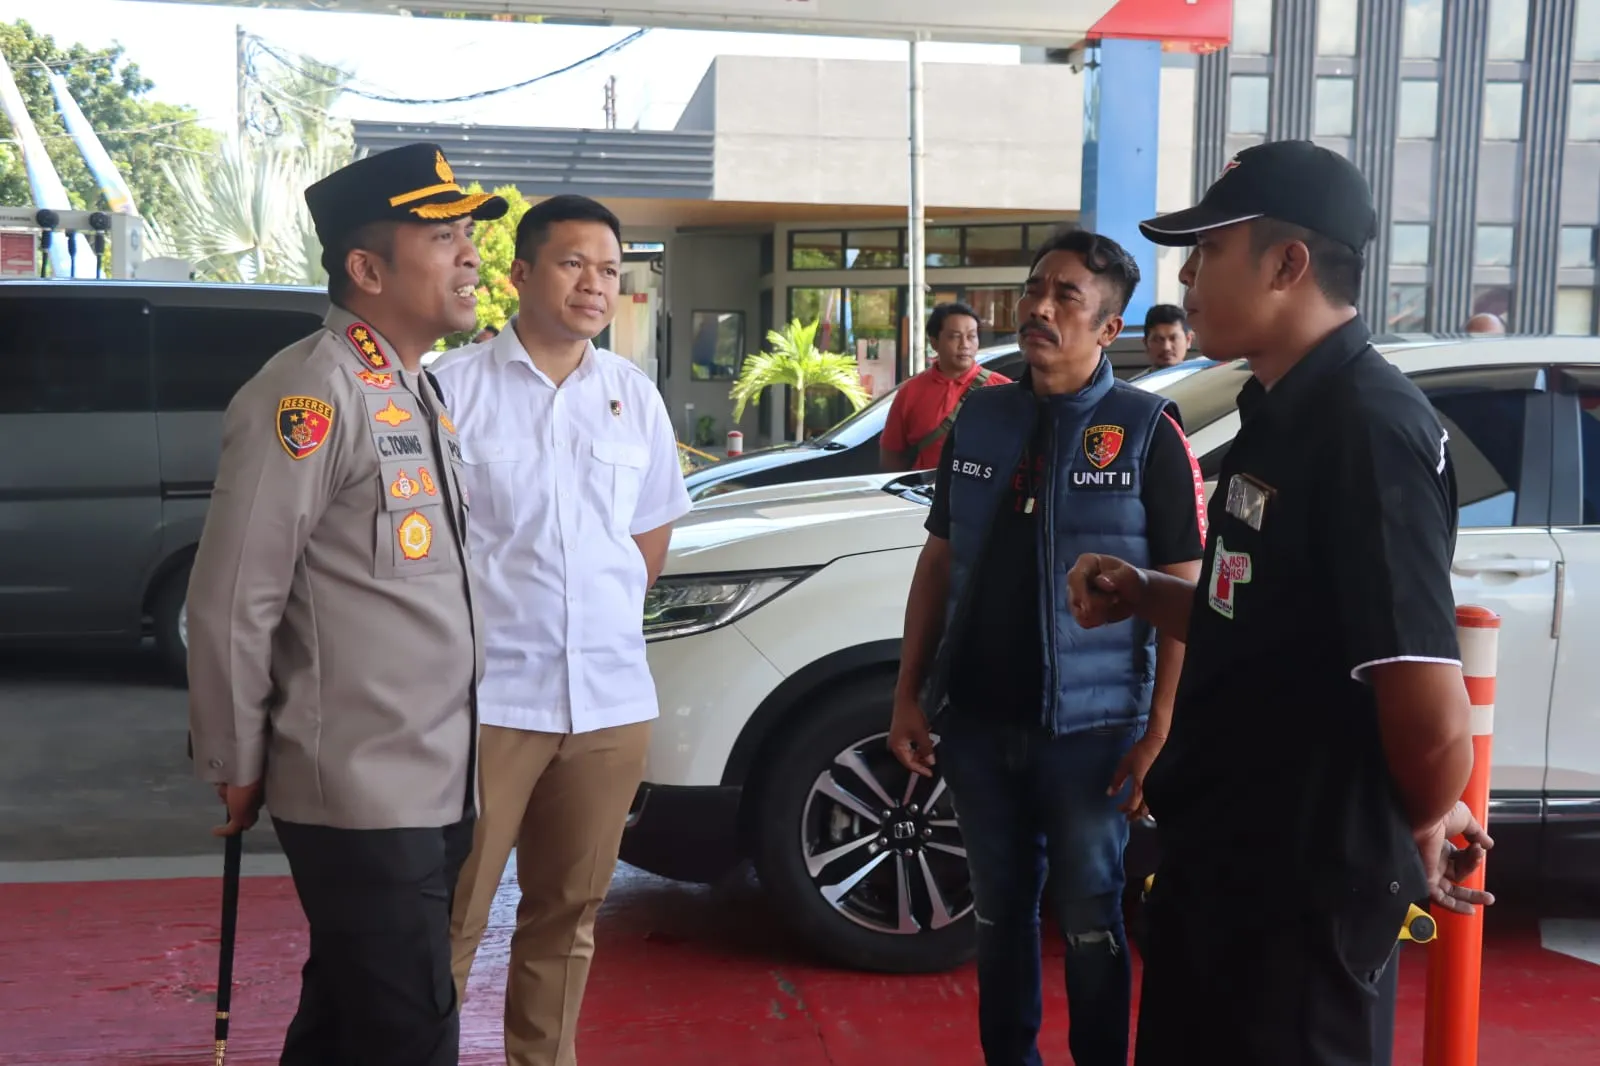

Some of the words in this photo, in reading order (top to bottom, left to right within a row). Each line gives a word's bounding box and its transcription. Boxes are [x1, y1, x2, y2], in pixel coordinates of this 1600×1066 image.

[284, 398, 330, 417] RESERSE
[377, 435, 423, 457] C.TOBING
[983, 466, 993, 479] S
[1073, 471, 1117, 485] UNIT
[1121, 471, 1131, 485] II
